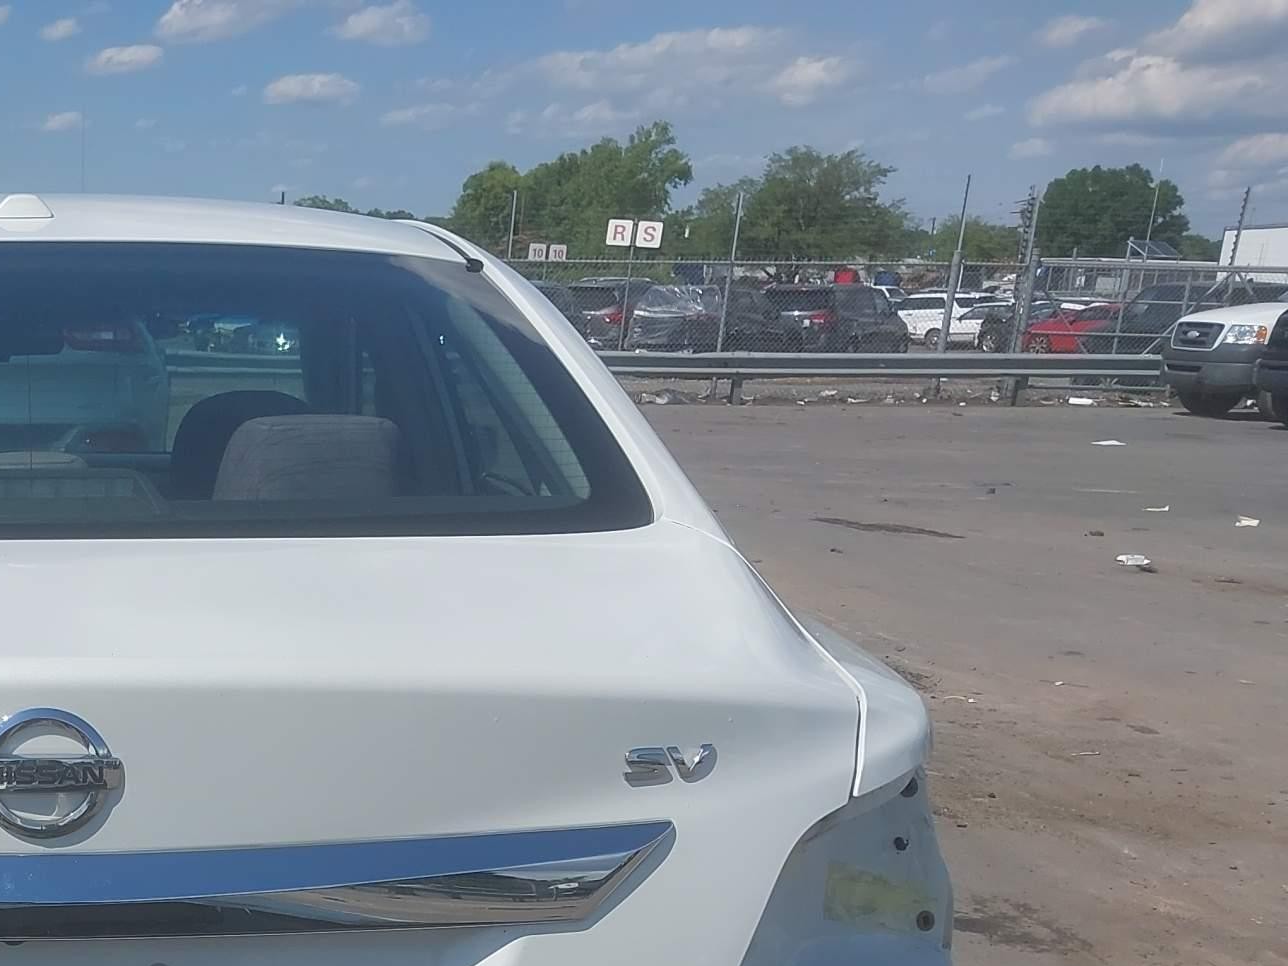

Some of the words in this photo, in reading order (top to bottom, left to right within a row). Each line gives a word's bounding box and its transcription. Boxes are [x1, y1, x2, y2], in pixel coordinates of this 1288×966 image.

[613, 225, 626, 241] R
[643, 226, 657, 242] S
[532, 248, 544, 259] 10
[552, 248, 564, 259] 10
[623, 743, 718, 788] SV
